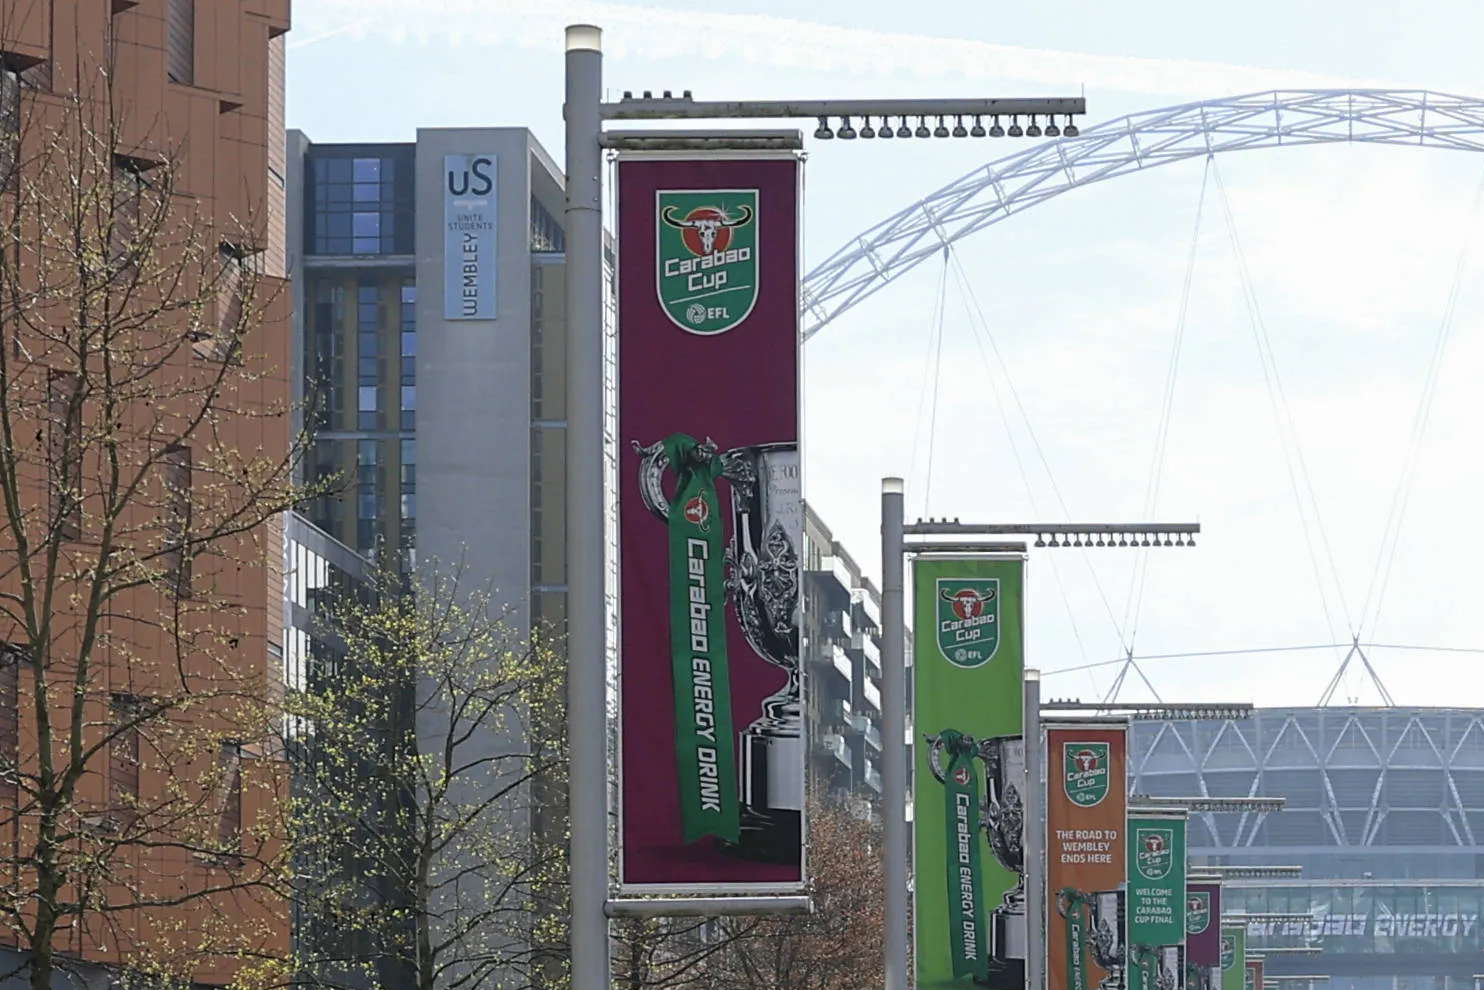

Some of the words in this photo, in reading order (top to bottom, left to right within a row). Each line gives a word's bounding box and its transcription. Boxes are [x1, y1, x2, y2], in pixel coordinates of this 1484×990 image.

[457, 214, 484, 222] UNITE
[448, 222, 493, 231] STUDENTS
[664, 247, 751, 277] Carabao
[463, 232, 479, 317] WEMBLEY
[687, 270, 728, 292] Cup
[707, 307, 730, 319] EFL
[687, 537, 711, 653] Carabao
[941, 614, 995, 633] Carabao
[955, 628, 981, 642] Cup
[690, 656, 716, 743] ENERGY
[697, 746, 721, 813] DRINK
[1066, 767, 1106, 782] Carabao
[1076, 778, 1096, 788] Cup
[956, 792, 972, 864] Carabao
[1056, 830, 1074, 840] THE
[1075, 830, 1103, 840] ROAD
[1104, 830, 1118, 840] TO
[1062, 842, 1111, 852] WEMBLEY
[1061, 854, 1086, 864] ENDS
[1087, 854, 1112, 864] HERE
[959, 866, 974, 919] ENERGY
[1135, 888, 1173, 897] WELCOME
[1141, 897, 1152, 906] TO
[1152, 897, 1168, 906] THE
[1136, 906, 1173, 916] CARABAO
[1134, 915, 1150, 925] CUP
[1150, 915, 1173, 925] FINAL
[1373, 913, 1476, 937] ENERGY
[962, 921, 977, 961] DRINK
